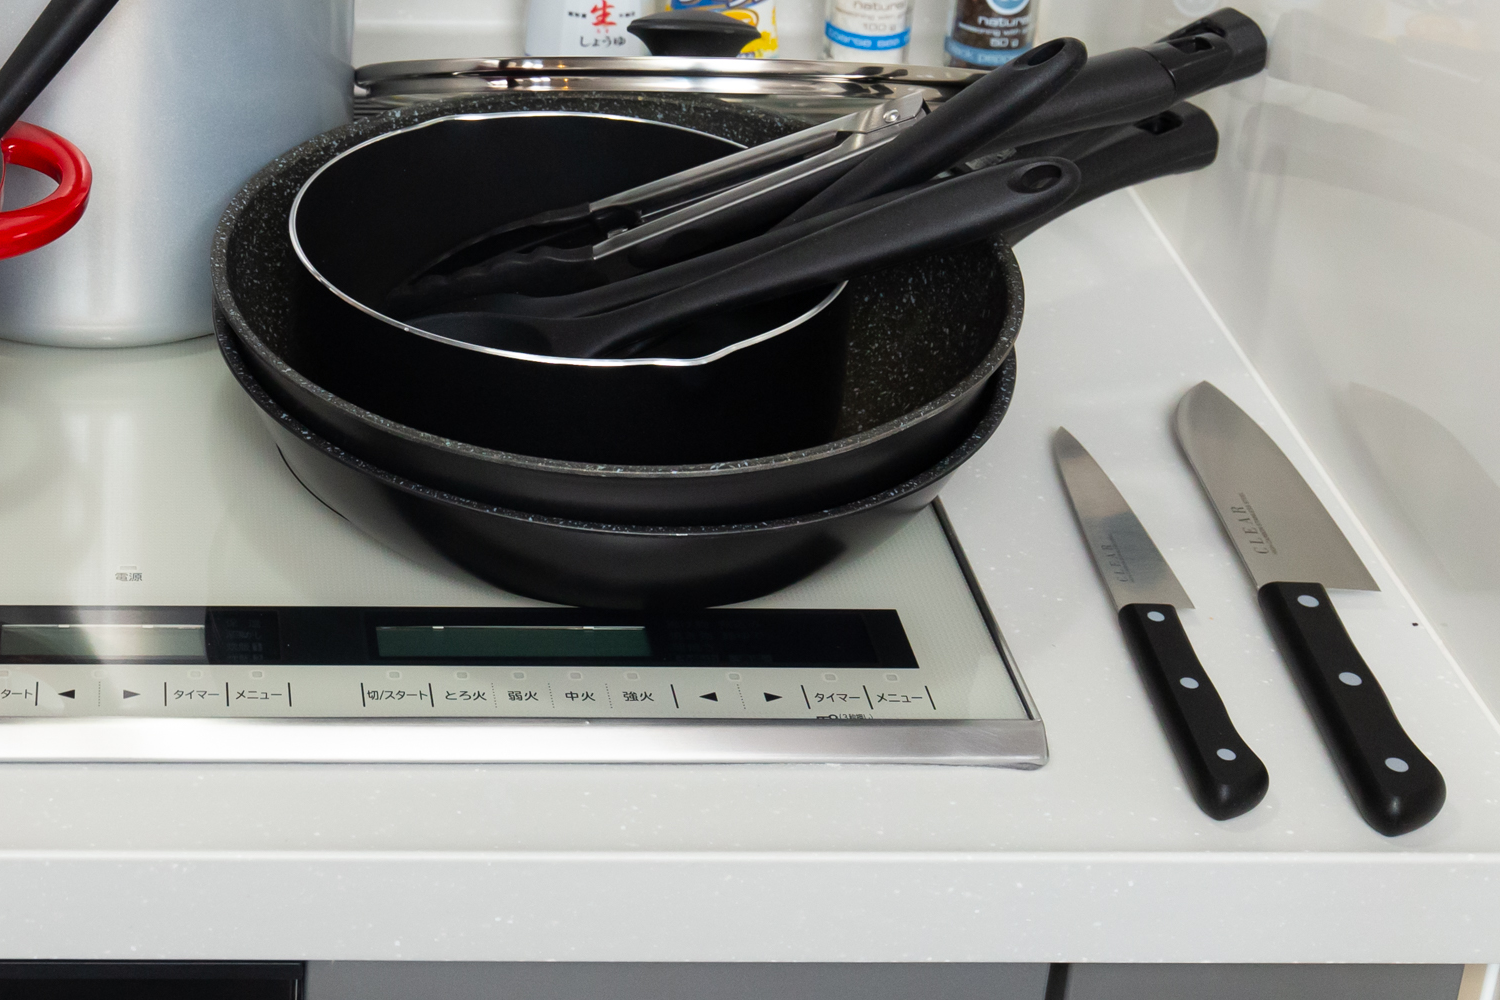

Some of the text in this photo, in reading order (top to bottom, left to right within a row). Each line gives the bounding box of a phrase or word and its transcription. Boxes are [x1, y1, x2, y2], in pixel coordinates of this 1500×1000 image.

[590, 0, 617, 26] 生
[580, 35, 626, 48] しょうゆ
[1231, 505, 1270, 555] CLEAR
[174, 688, 219, 700] タイマー
[235, 688, 282, 700] メニュー
[367, 690, 428, 701] 切/スタート
[445, 690, 487, 701] とろ火
[507, 690, 539, 701] 弱火
[565, 690, 596, 701] 中火
[623, 690, 655, 701] 強火
[814, 692, 861, 703] タイマー
[876, 693, 923, 703] メニュー
